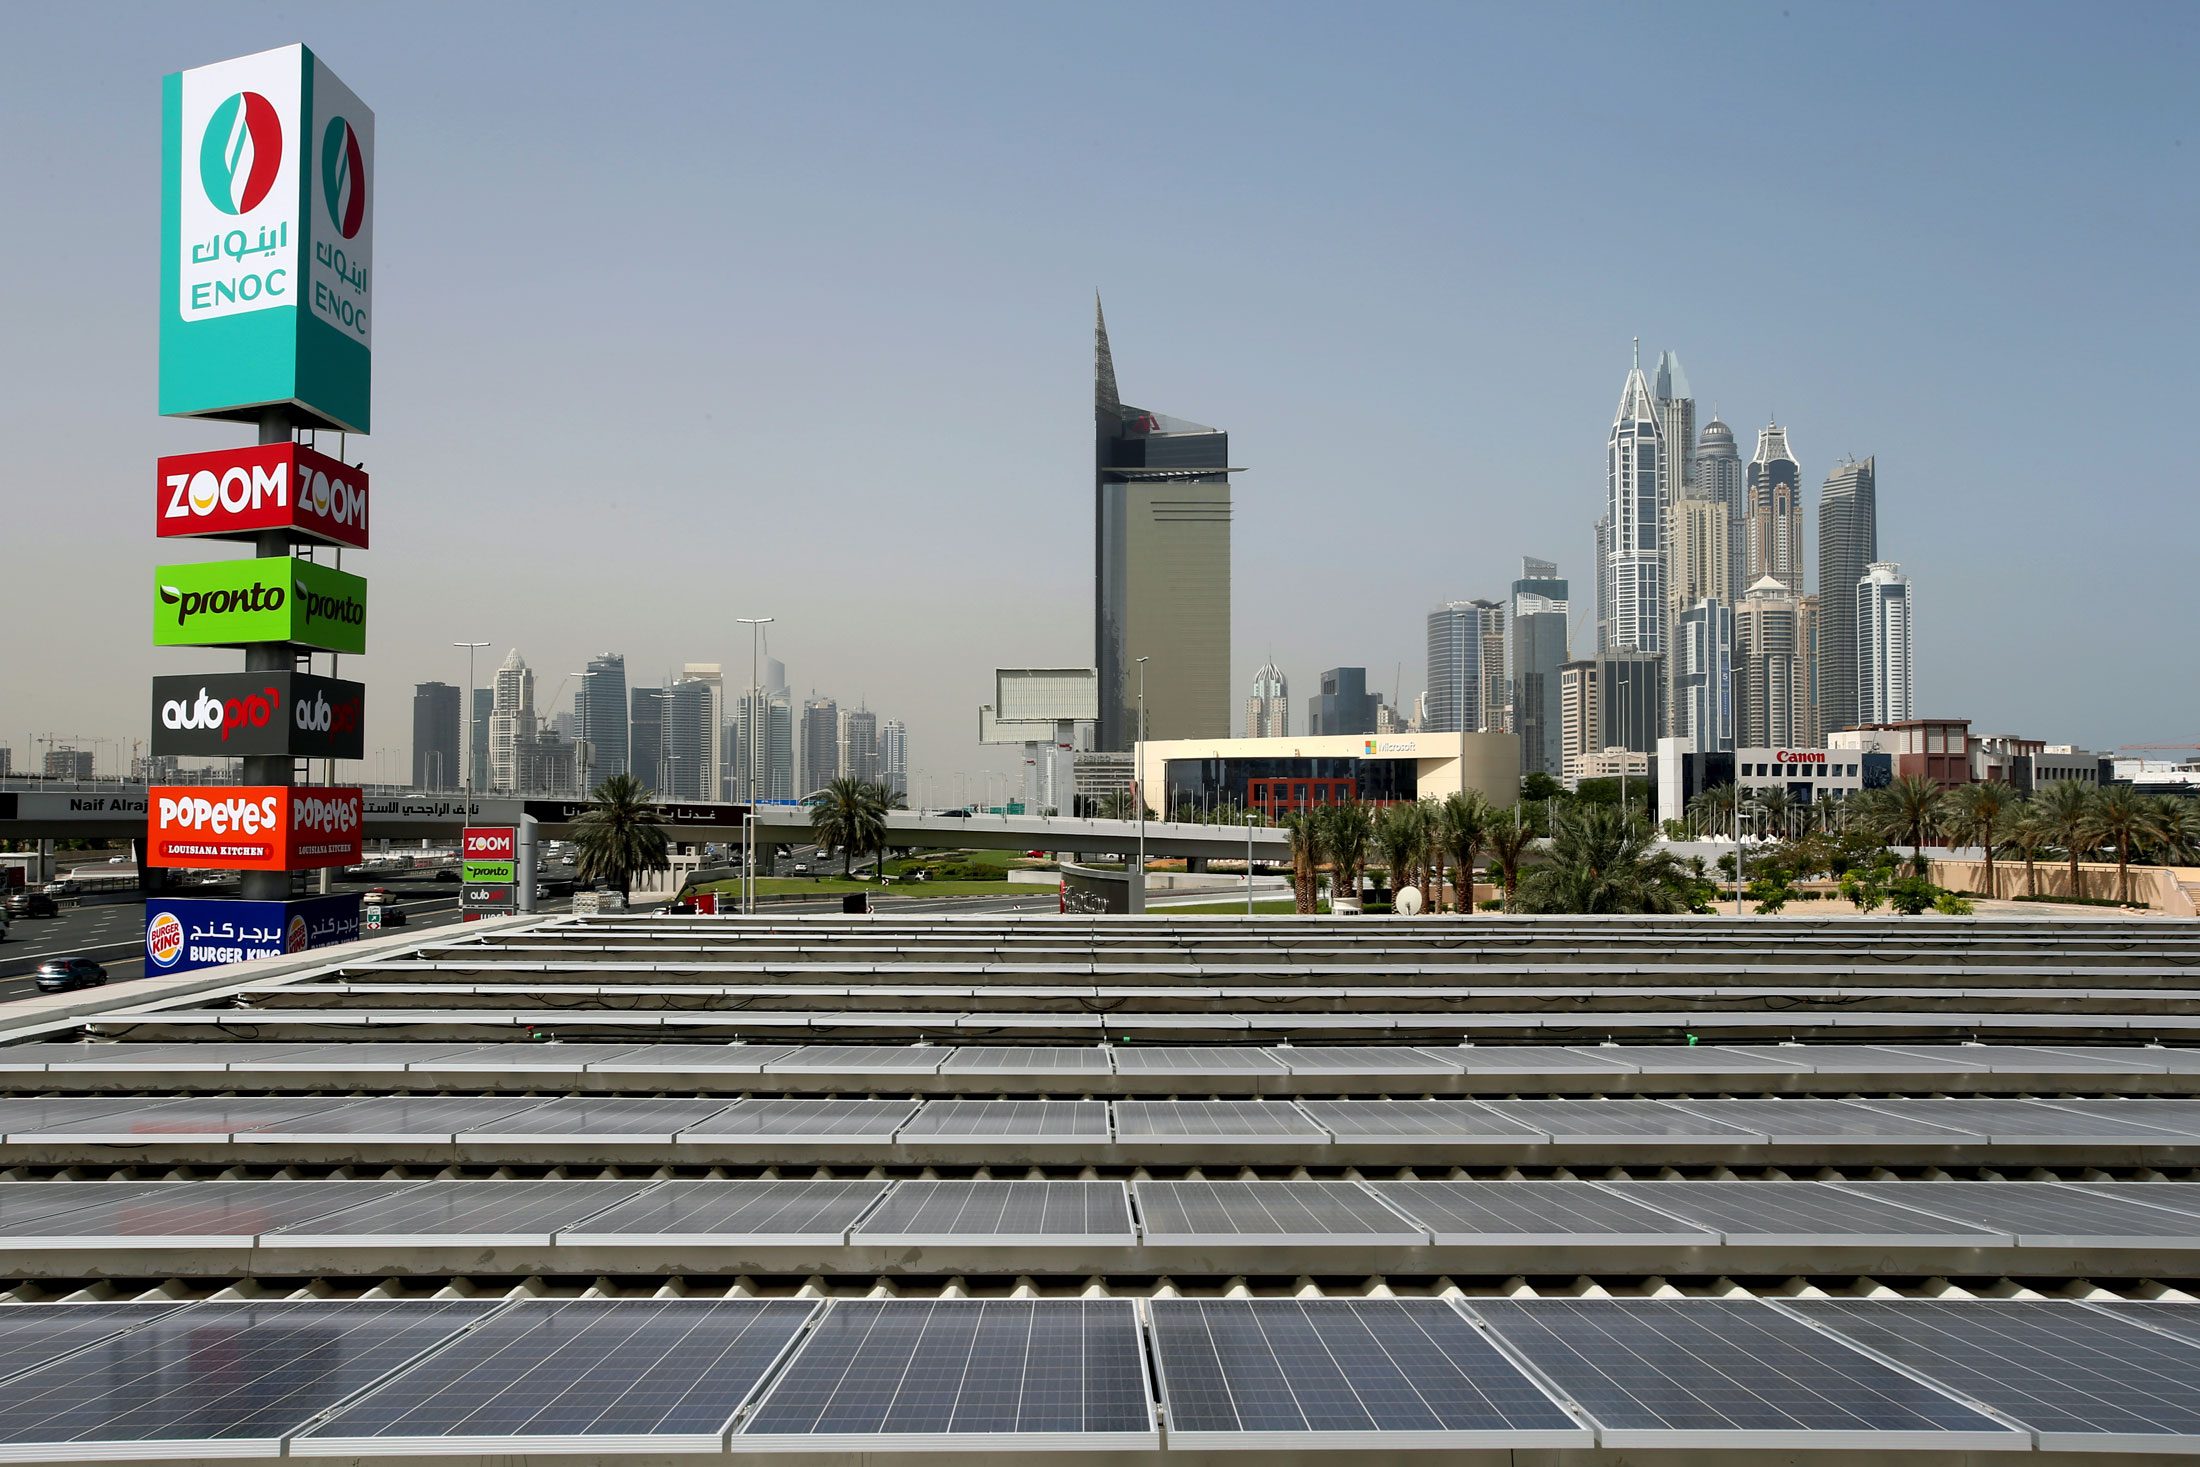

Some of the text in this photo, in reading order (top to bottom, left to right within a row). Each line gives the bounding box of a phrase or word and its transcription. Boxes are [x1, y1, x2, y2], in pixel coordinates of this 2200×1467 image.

[192, 221, 287, 264] اينوك
[316, 240, 367, 295] اينوك
[192, 268, 287, 310] ENOC
[315, 280, 367, 335] ENOC
[164, 462, 288, 518] ZOOM
[297, 463, 366, 530] ZOOM
[178, 582, 285, 626] pronto
[305, 592, 364, 625] pronto
[162, 686, 272, 742] autopro
[1379, 742, 1416, 752] Microsoft
[1776, 751, 1826, 763] Canon
[70, 799, 104, 811] Naif
[168, 844, 264, 856] LOUISIANA KITCHEN
[298, 844, 352, 855] LOUISIANA KITCHEN
[467, 836, 510, 851] ZOOM
[473, 866, 509, 878] pronto
[151, 923, 179, 941] BURGER
[152, 932, 180, 954] KING
[190, 921, 282, 944] برجر كنج
[190, 946, 243, 963] BURGER
